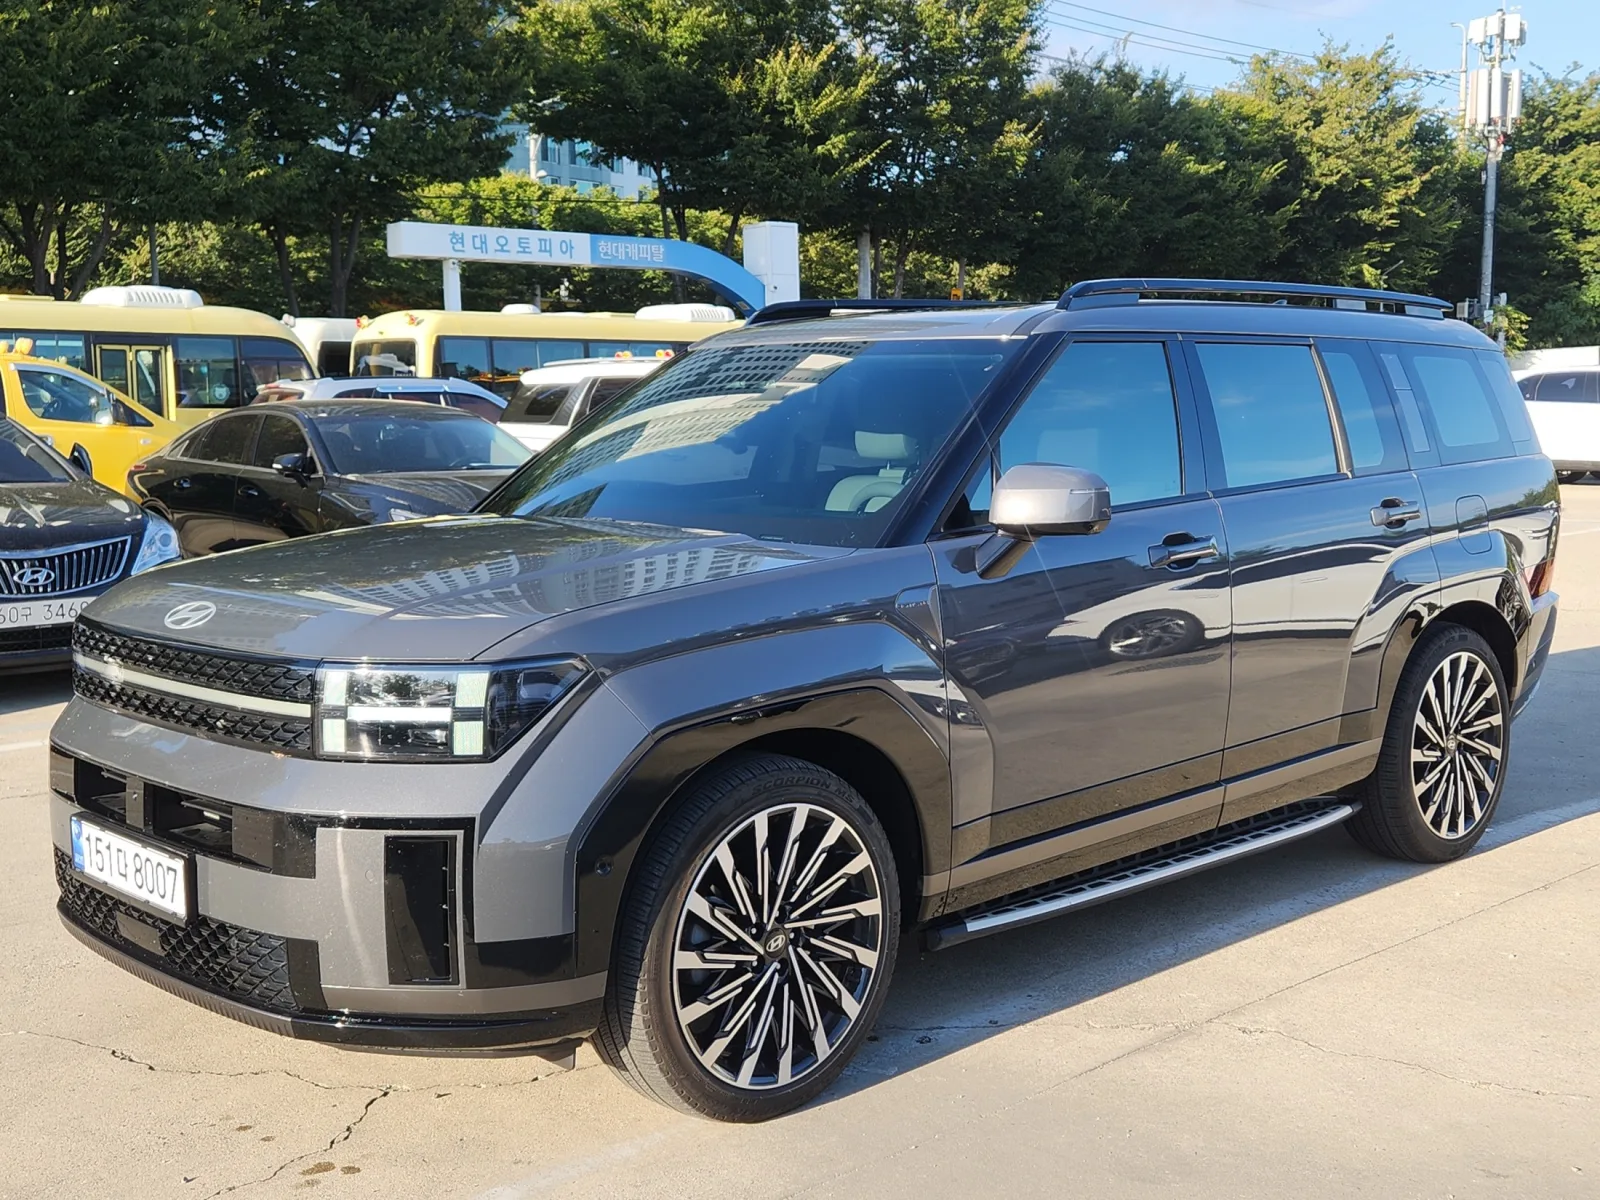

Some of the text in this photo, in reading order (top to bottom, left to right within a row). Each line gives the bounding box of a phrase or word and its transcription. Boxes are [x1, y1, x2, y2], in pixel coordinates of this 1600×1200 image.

[448, 230, 575, 259] 현대오토피아
[598, 240, 665, 263] 현대캐피탈
[751, 775, 832, 796] SCORPION
[133, 852, 178, 904] 8007
